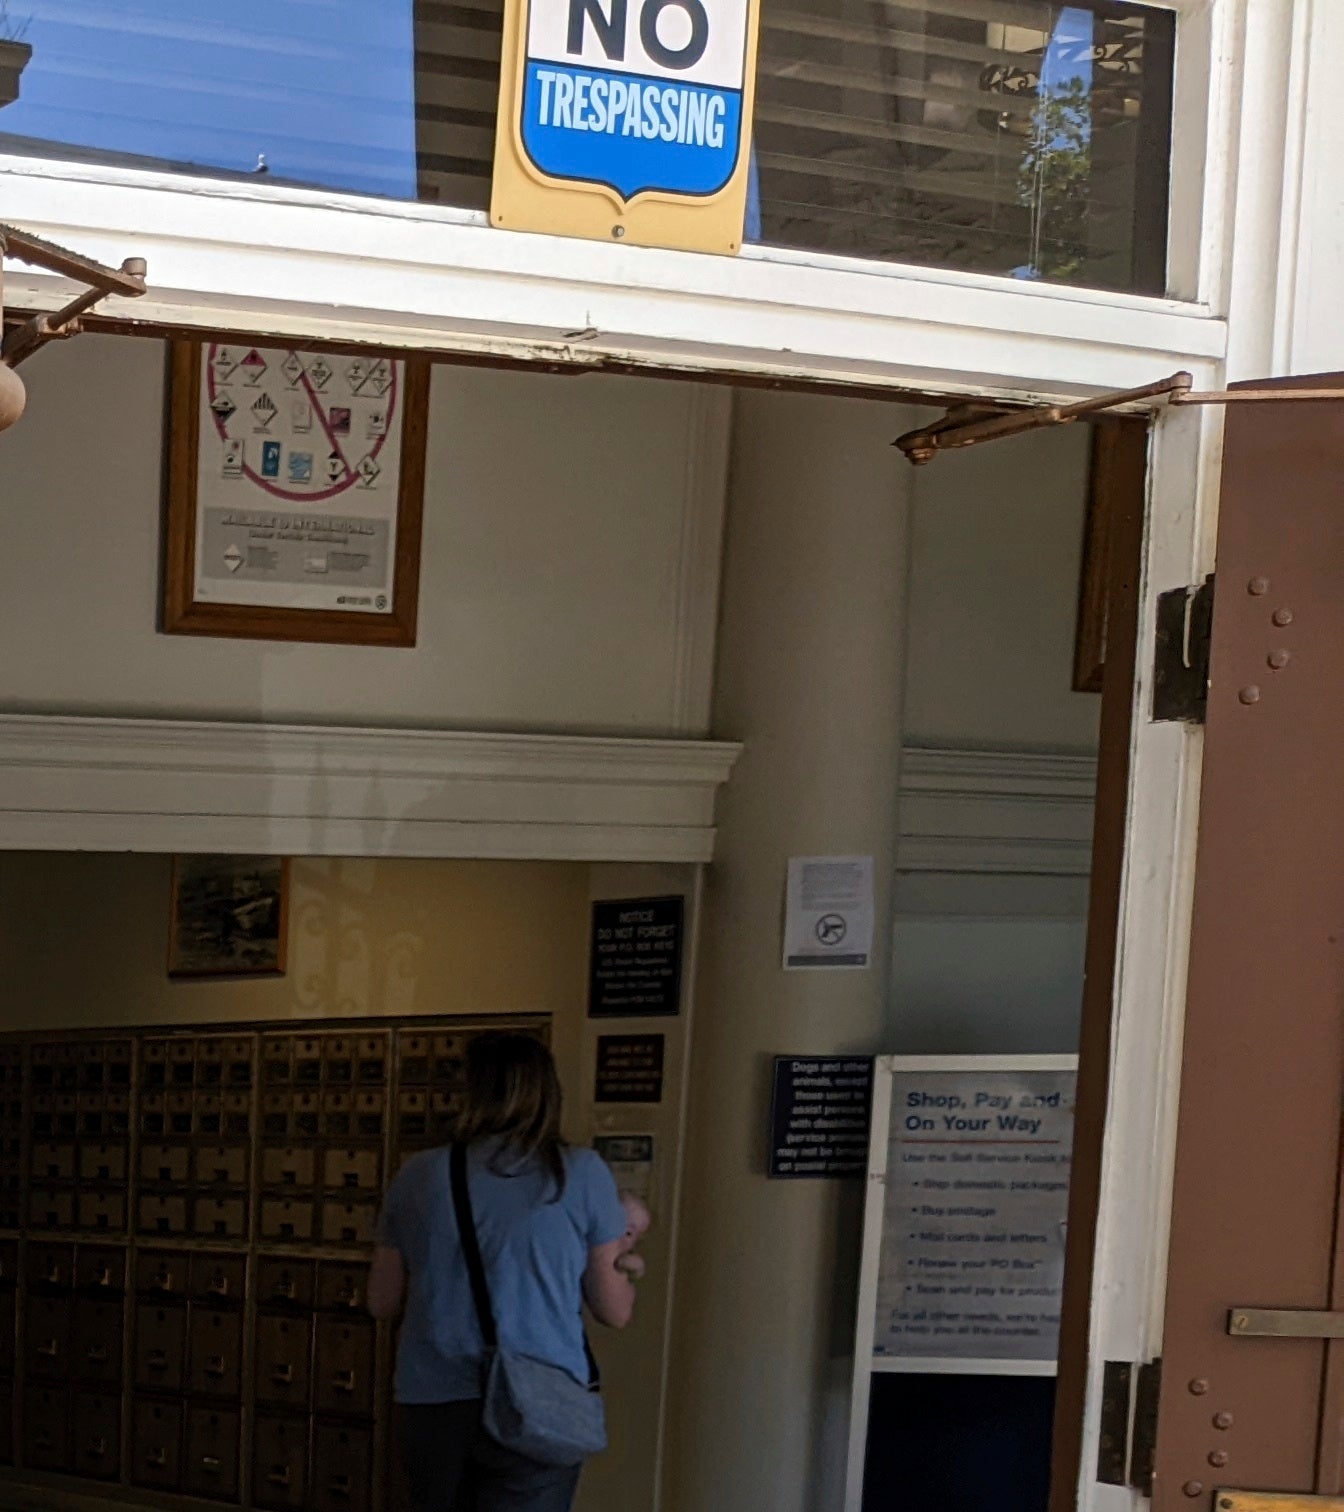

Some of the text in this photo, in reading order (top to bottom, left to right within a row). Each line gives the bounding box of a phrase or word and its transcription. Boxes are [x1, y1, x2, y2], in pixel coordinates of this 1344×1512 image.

[566, 0, 709, 70] NO
[536, 70, 725, 149] TRESPASSING
[907, 1092, 1060, 1110] Shop, Pay and
[906, 1115, 1041, 1133] On Your Way
